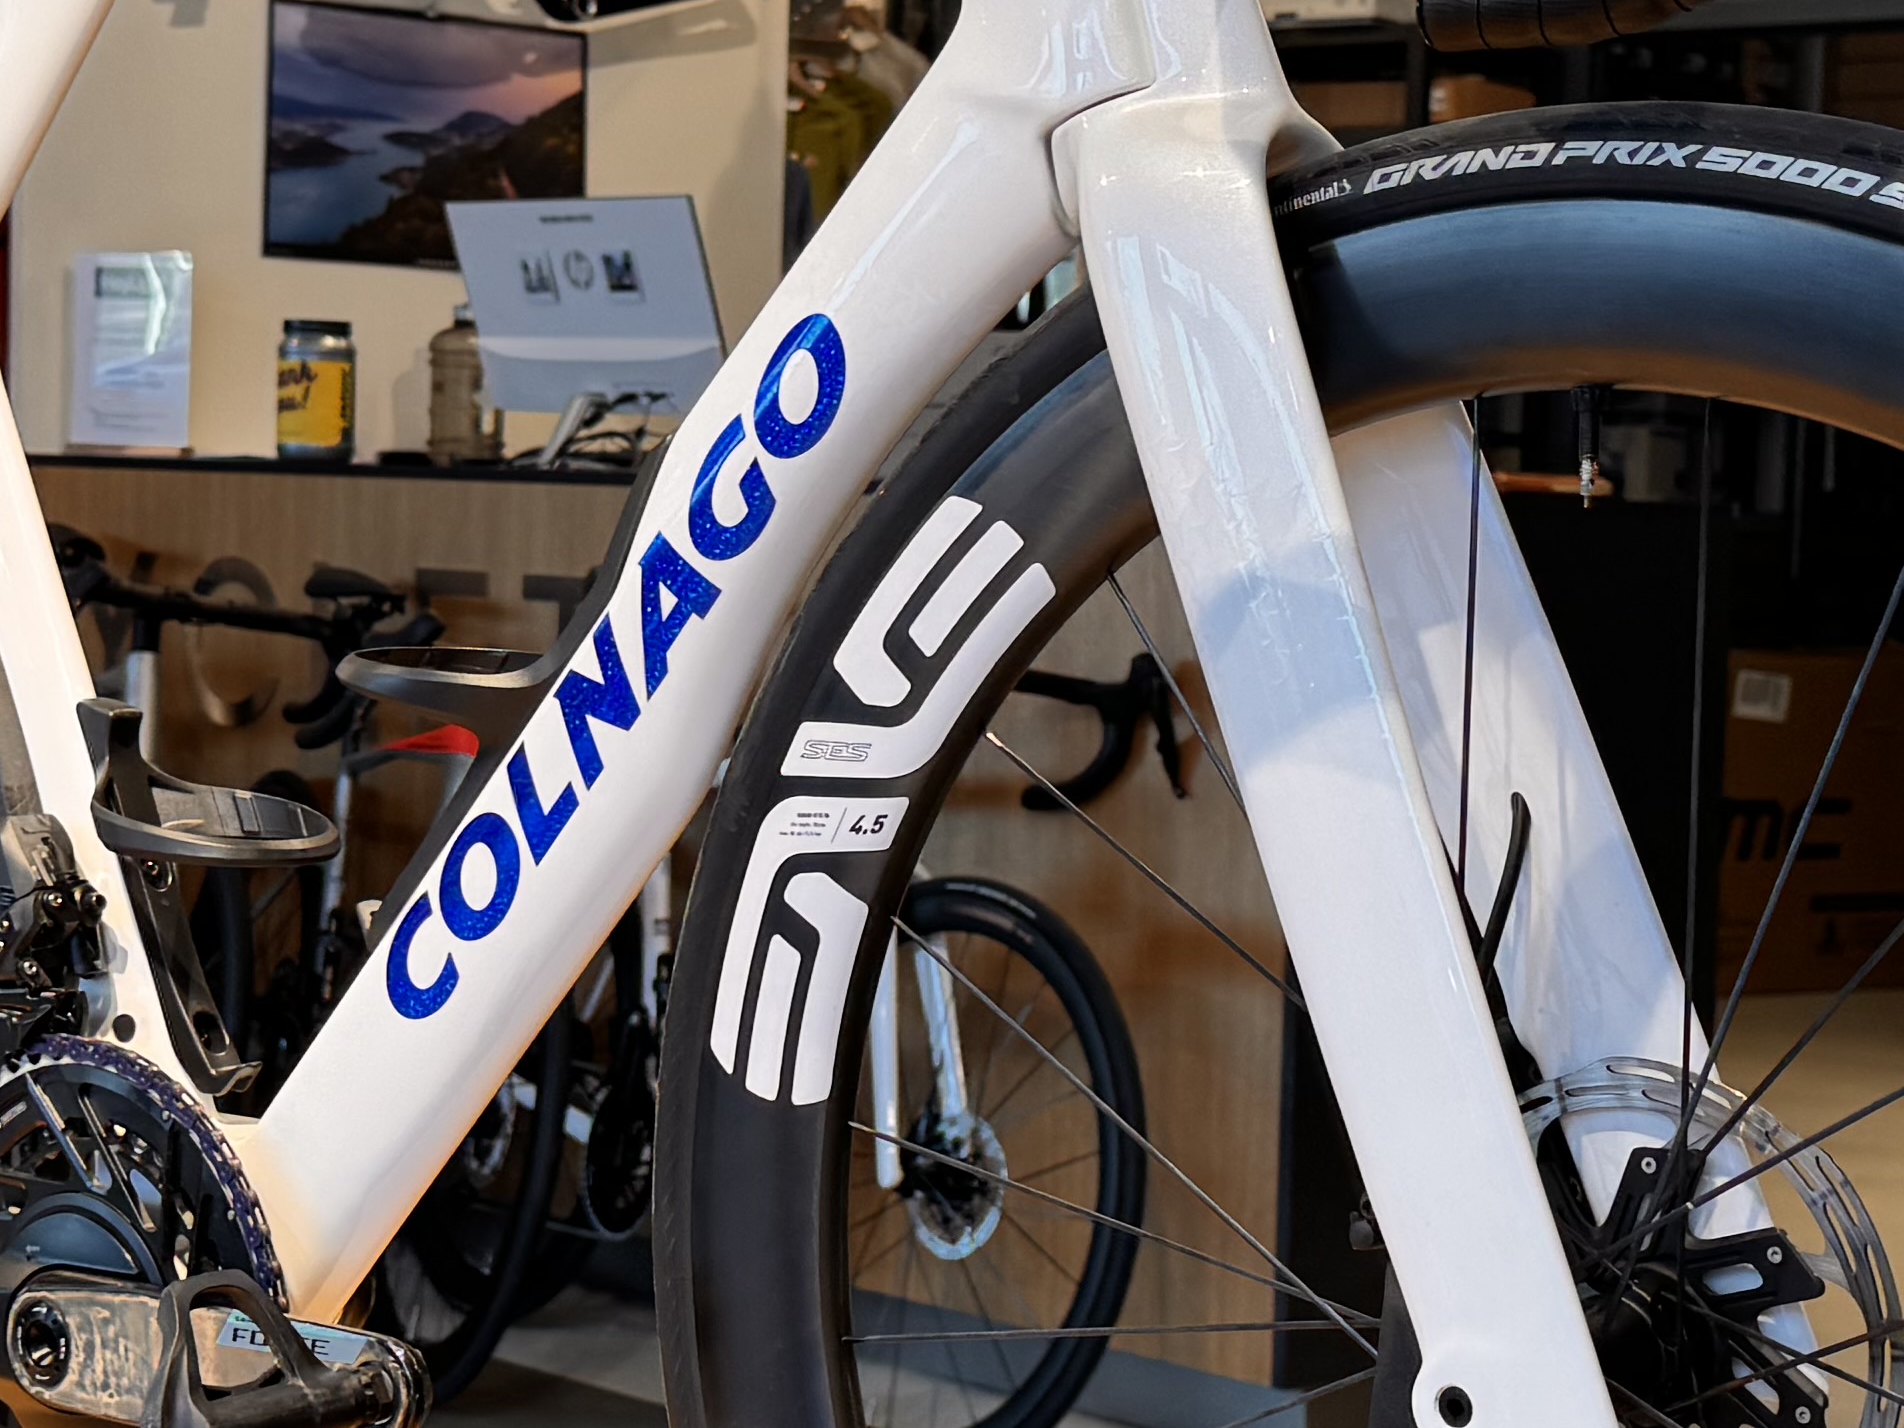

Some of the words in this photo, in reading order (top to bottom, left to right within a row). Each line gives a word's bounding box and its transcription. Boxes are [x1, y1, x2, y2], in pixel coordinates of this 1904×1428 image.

[1364, 143, 1556, 194] GRAND
[1552, 141, 1703, 168] PRIX
[1696, 147, 1880, 196] 5000
[386, 313, 846, 1020] COLNAGO
[800, 739, 872, 762] SES
[849, 814, 889, 835] 4.5
